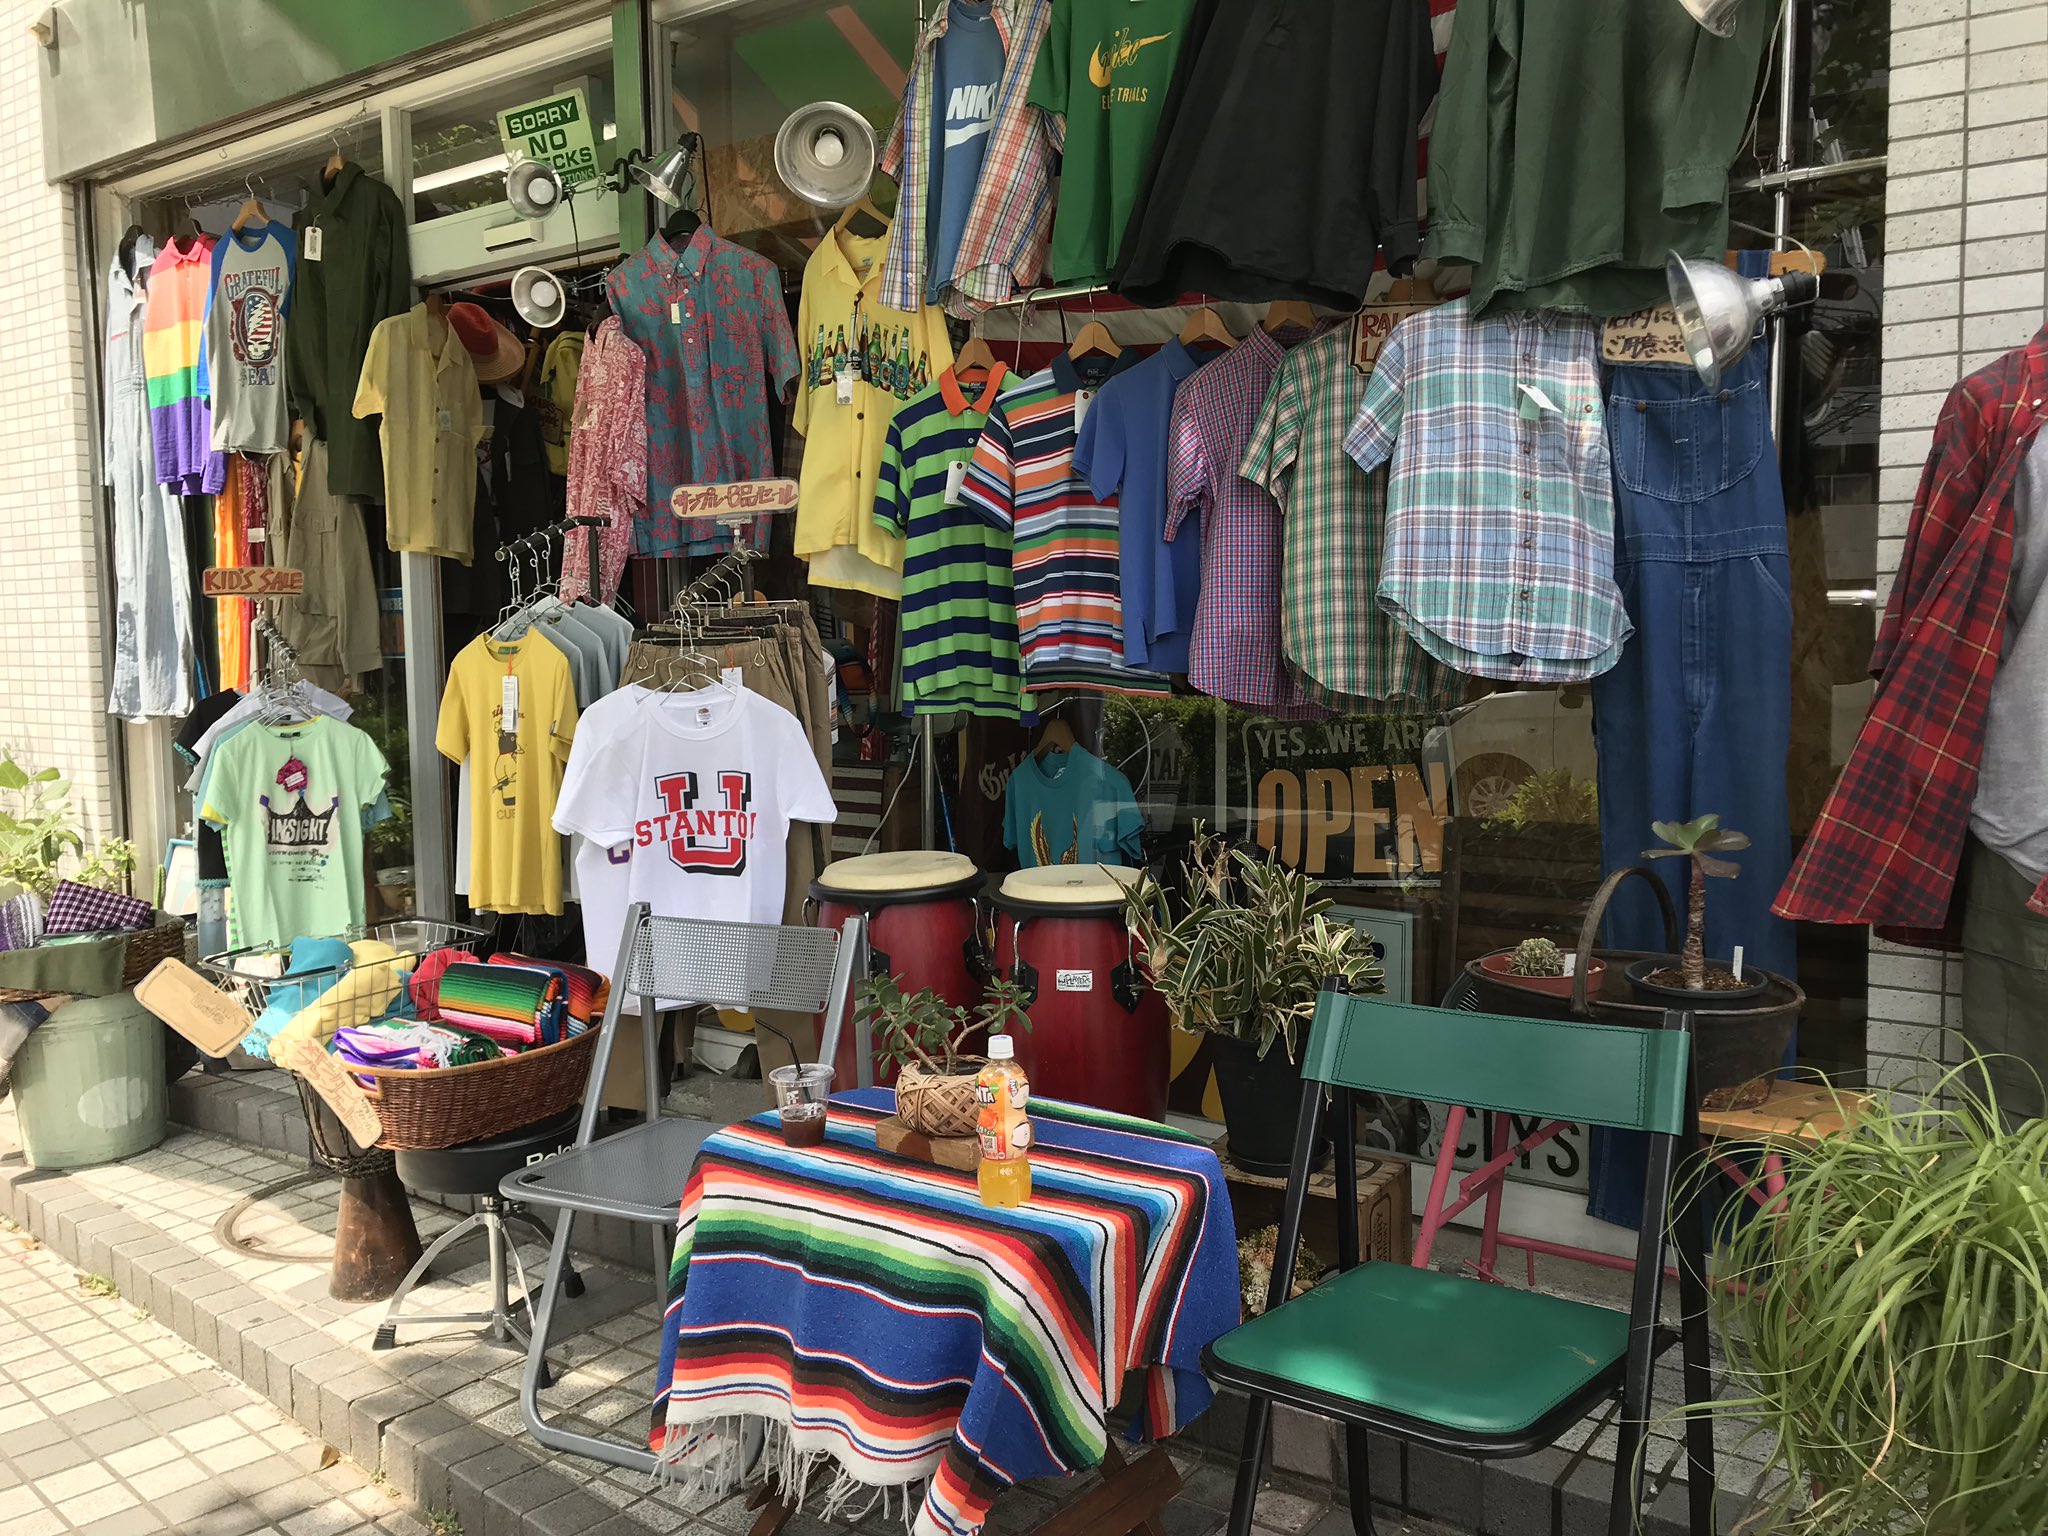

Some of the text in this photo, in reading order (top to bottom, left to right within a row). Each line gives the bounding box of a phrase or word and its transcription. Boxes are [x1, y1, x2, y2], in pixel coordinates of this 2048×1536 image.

[509, 102, 573, 134] SORRY
[528, 128, 567, 156] NO
[224, 266, 283, 301] GRATEFUL
[204, 568, 303, 593] KID'S SALE
[271, 818, 328, 843] INSIGHT
[1256, 761, 1449, 874] OPEN
